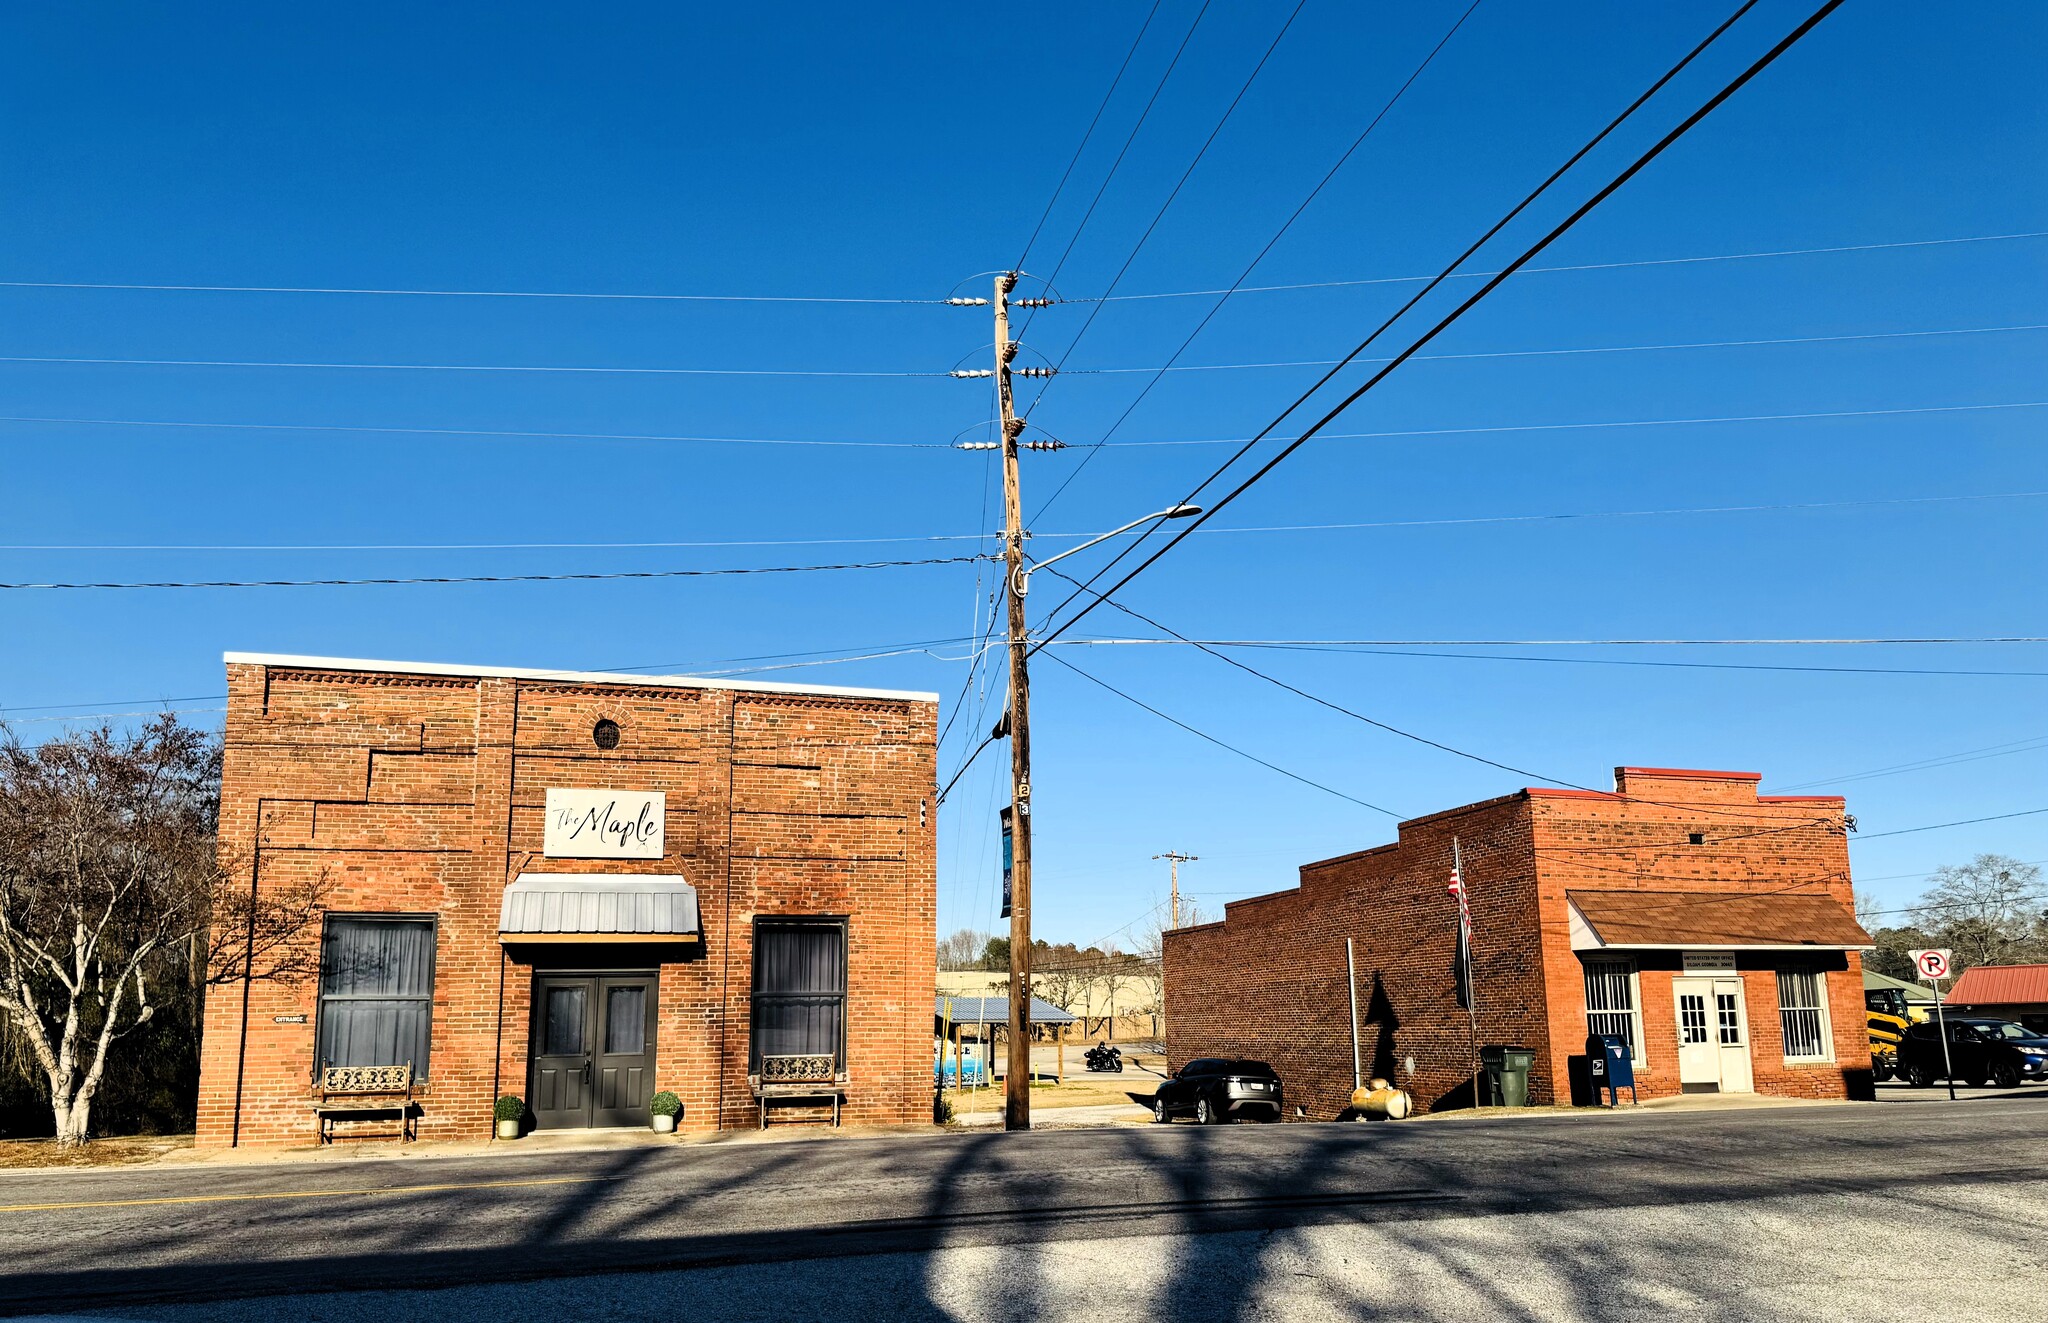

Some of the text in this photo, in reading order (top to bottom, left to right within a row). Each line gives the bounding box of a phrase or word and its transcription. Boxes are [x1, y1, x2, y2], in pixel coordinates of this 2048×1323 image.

[1021, 786, 1028, 795] 2
[1021, 805, 1029, 814] 3
[553, 801, 659, 847] The Maple
